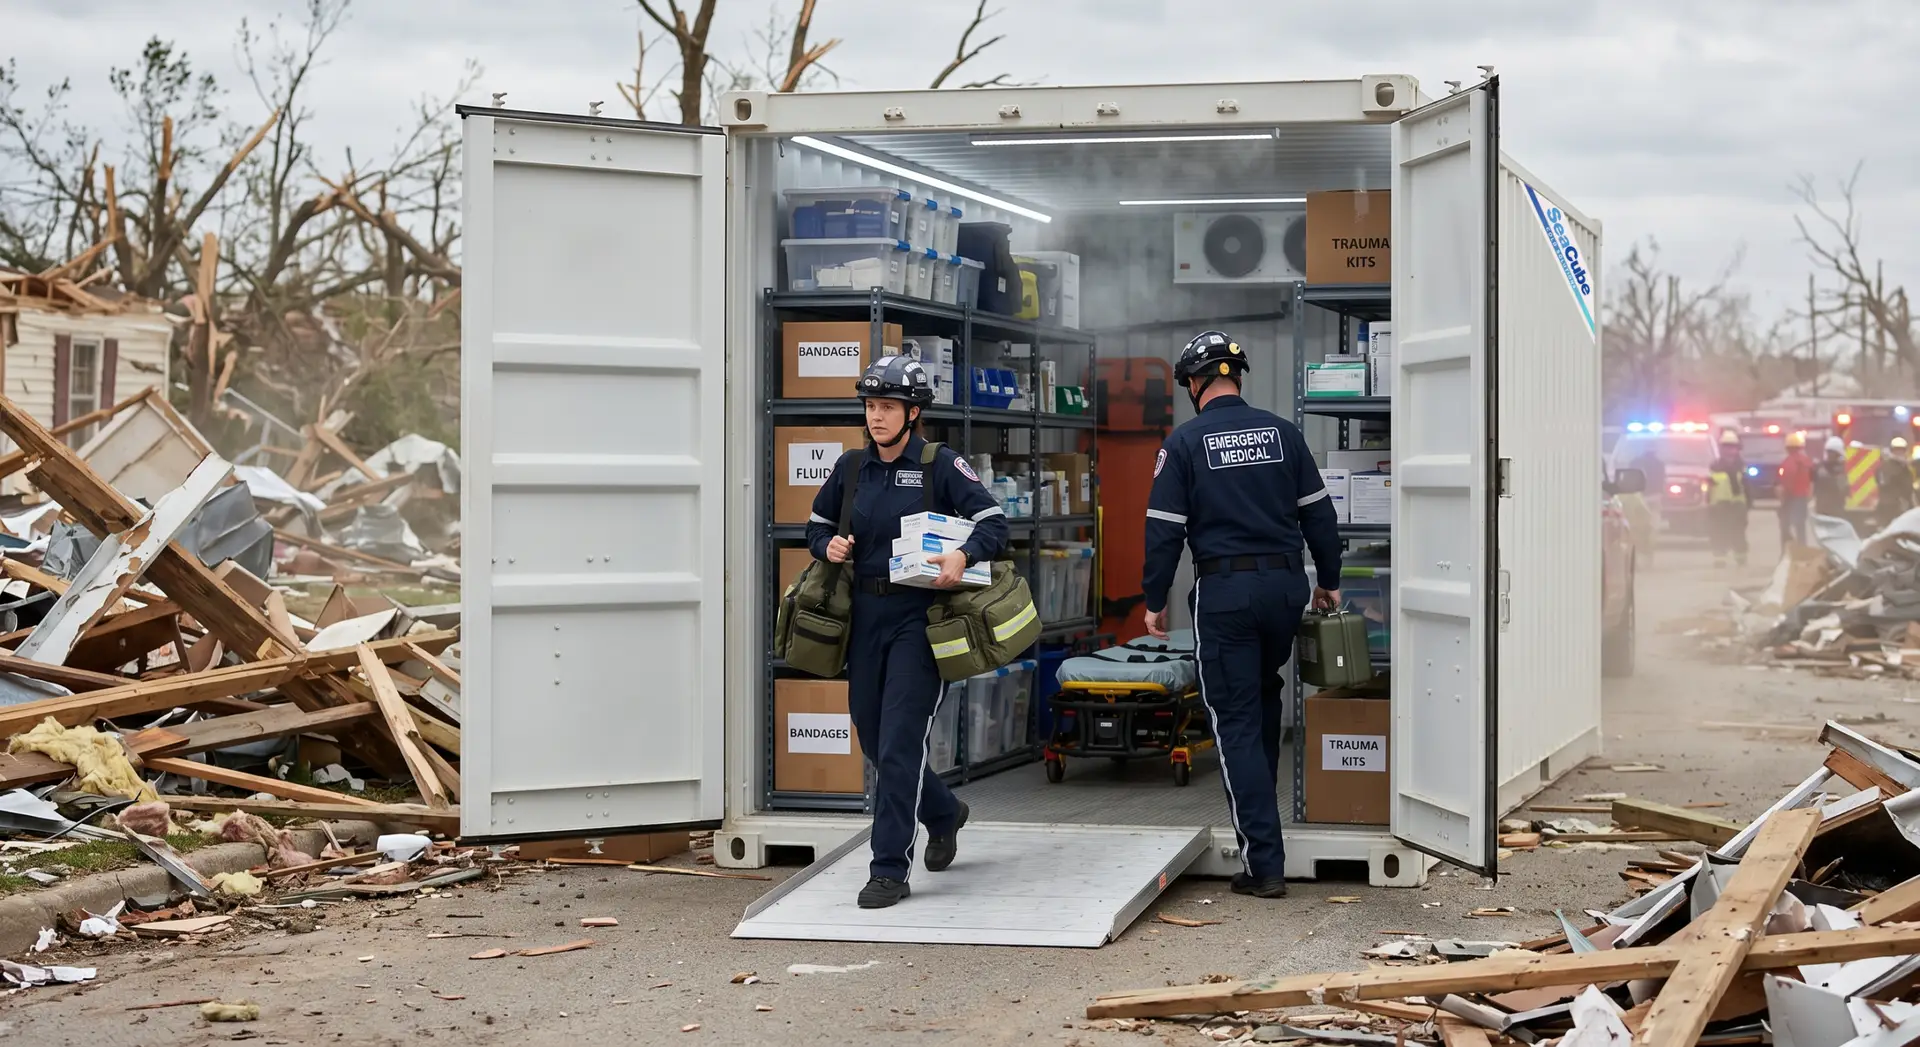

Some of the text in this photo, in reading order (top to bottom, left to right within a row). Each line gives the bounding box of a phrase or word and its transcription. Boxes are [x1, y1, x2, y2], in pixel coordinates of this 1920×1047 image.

[1331, 238, 1390, 250] TRAUMA
[1546, 207, 1591, 296] SeaCube
[1346, 256, 1376, 268] KITS
[1556, 249, 1577, 289] SOLUTIONS
[799, 346, 860, 357] BANDAGES
[1207, 430, 1275, 451] EMERGENCY
[811, 449, 824, 460] IV
[1220, 446, 1271, 465] MEDICAL
[796, 468, 832, 479] FLUID
[790, 728, 849, 739] BANDAGES
[1329, 740, 1379, 750] TRAUMA
[1342, 757, 1366, 767] KITS
